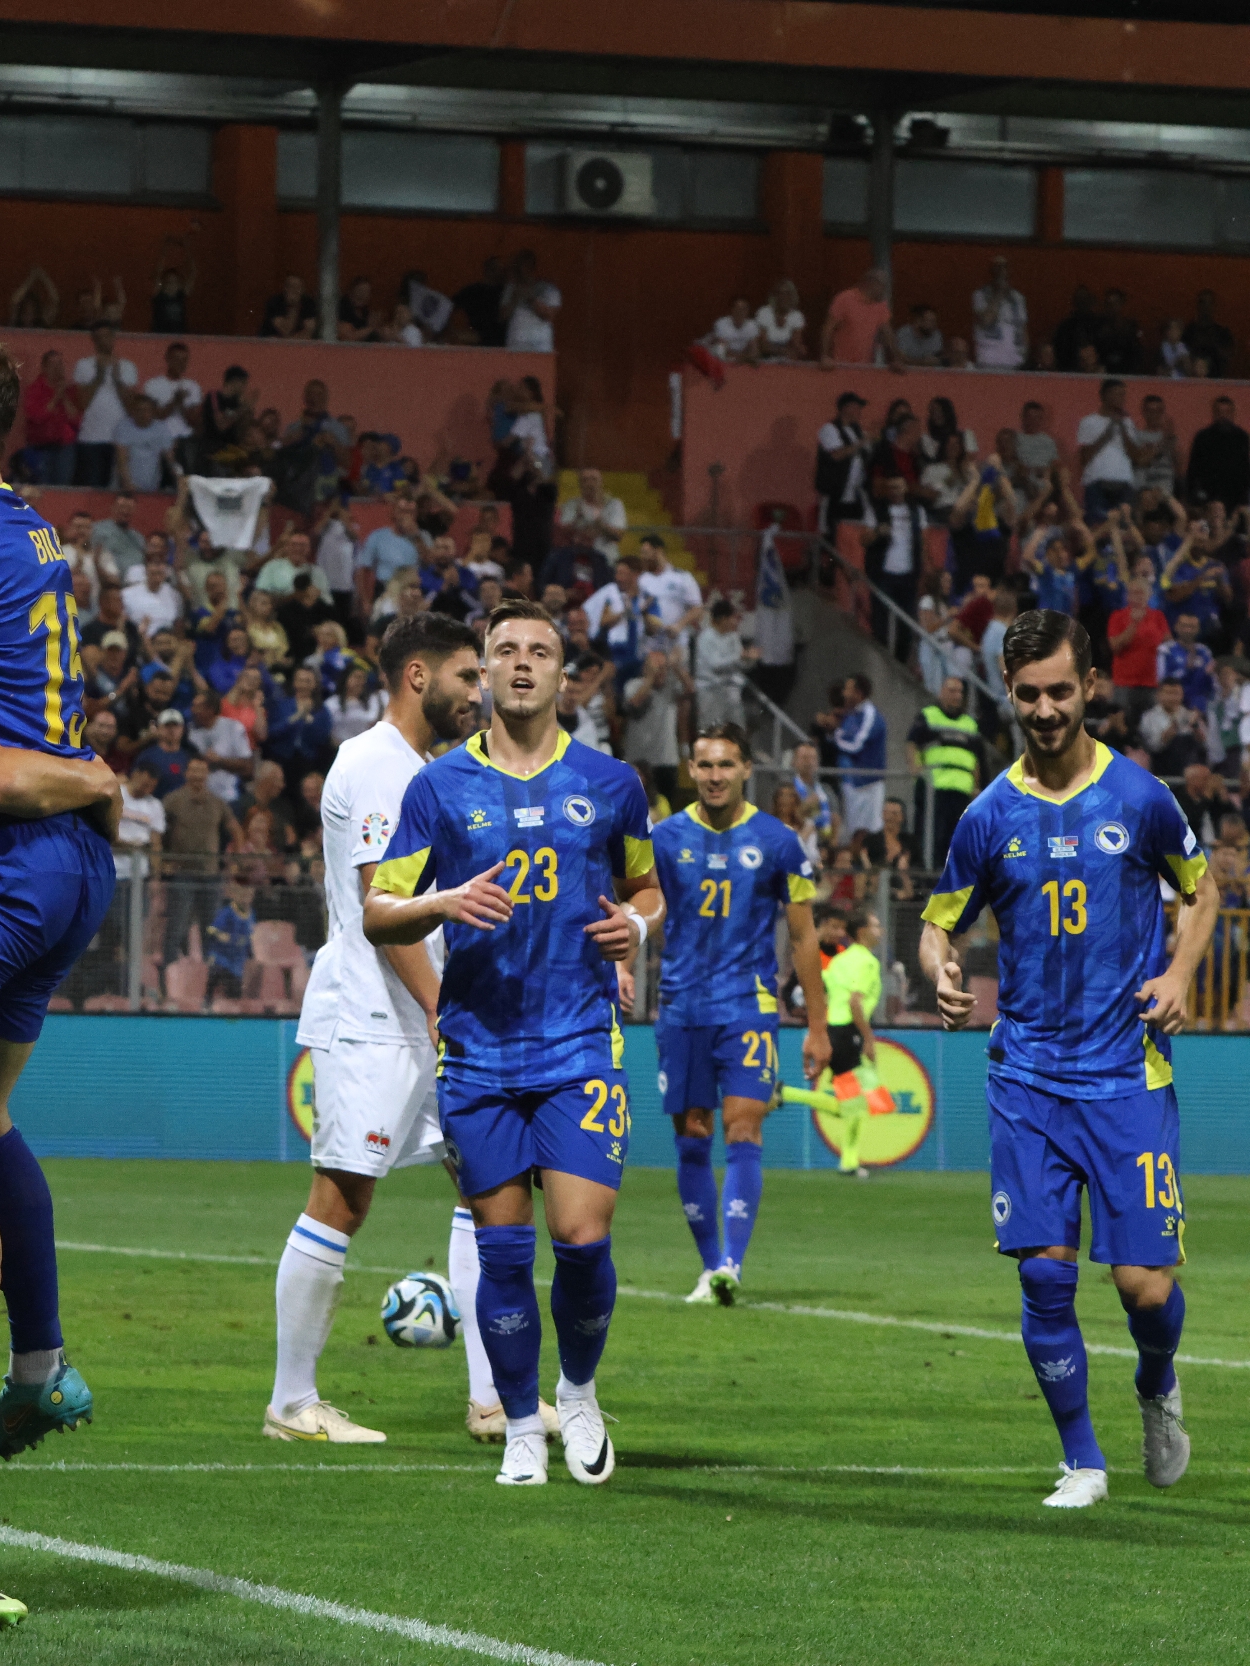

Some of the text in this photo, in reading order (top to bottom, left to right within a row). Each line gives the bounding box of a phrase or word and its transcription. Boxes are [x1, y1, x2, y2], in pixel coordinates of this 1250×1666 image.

[467, 821, 492, 831] KELME
[505, 846, 559, 904] 23
[1003, 850, 1027, 859] KELME
[699, 879, 731, 917] 21
[1041, 879, 1088, 936] 13
[742, 1030, 772, 1068] 21
[580, 1079, 626, 1137] 23
[1136, 1152, 1175, 1208] 13
